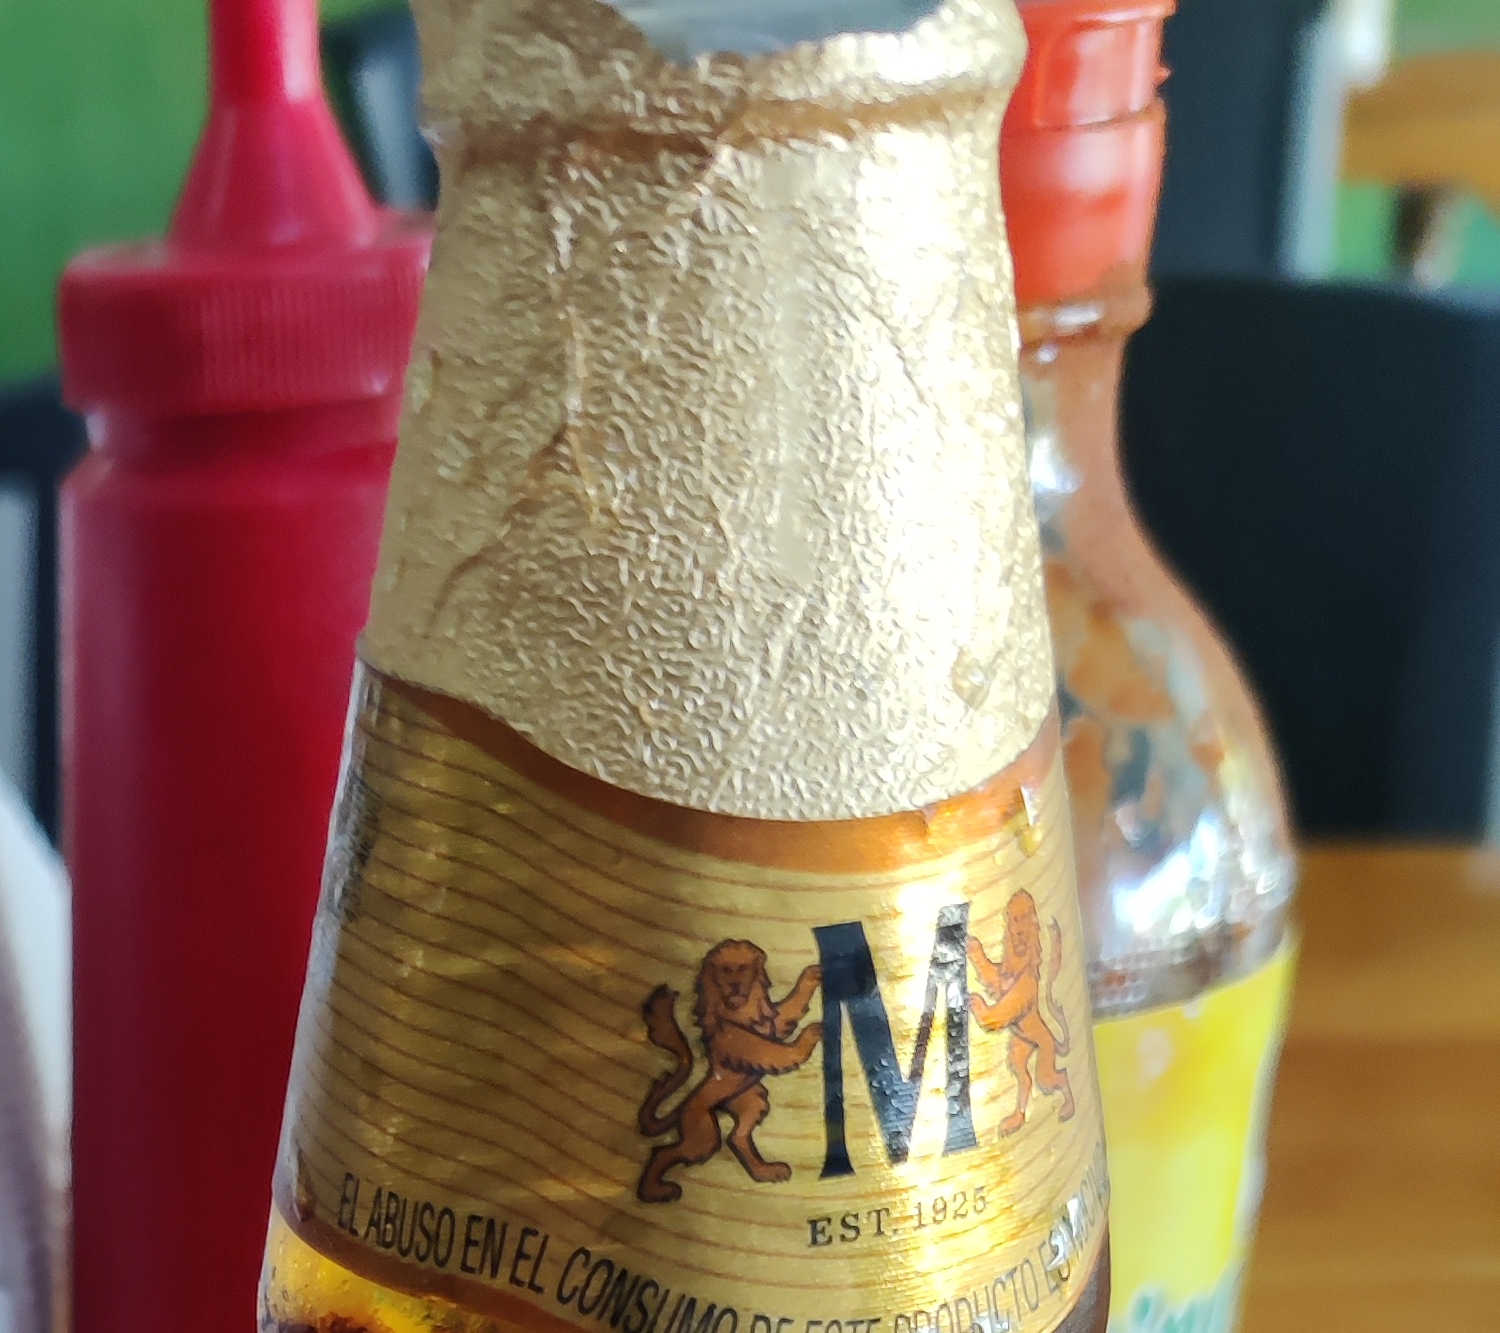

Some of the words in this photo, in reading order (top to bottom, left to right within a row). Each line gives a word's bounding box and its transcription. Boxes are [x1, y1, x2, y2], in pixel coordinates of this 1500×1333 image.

[811, 900, 977, 1179] M
[337, 1171, 360, 1238] EL
[363, 1186, 457, 1269] ABUSO
[460, 1213, 509, 1280] EN
[508, 1226, 550, 1294] EL
[806, 1207, 900, 1248] EST.
[912, 1184, 989, 1231] 1925
